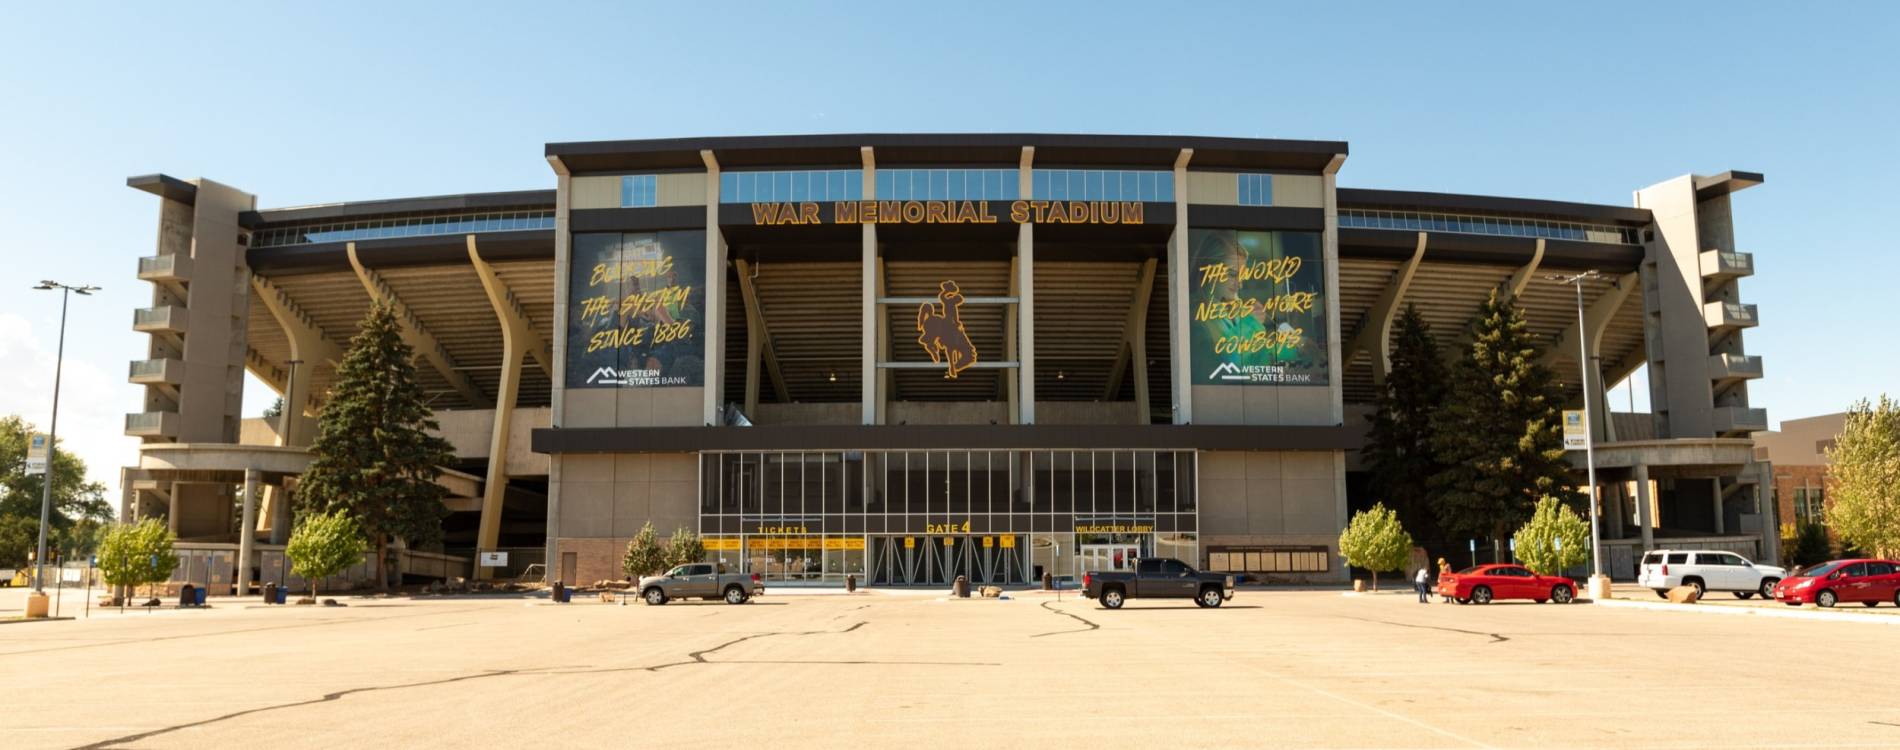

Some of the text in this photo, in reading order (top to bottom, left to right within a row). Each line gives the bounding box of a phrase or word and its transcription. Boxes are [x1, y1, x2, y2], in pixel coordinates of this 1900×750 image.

[752, 200, 1144, 225] WAR MEMORIAL STADIUM
[1199, 256, 1302, 295] THE WORLD
[581, 286, 692, 327] THE SYSTEM
[1195, 291, 1318, 322] NEEDS MORE
[587, 319, 693, 353] SINCE 1886.
[1214, 328, 1305, 355] COWBOYS.
[618, 369, 660, 377] WESTERN
[1242, 366, 1284, 374] WESTERN
[628, 376, 687, 386] STATES BANK
[1251, 373, 1311, 382] STATES BANK
[758, 526, 807, 535] TICKETS
[927, 521, 970, 534] GATE 4
[1075, 525, 1153, 534] WILDCATTER LOBBY
